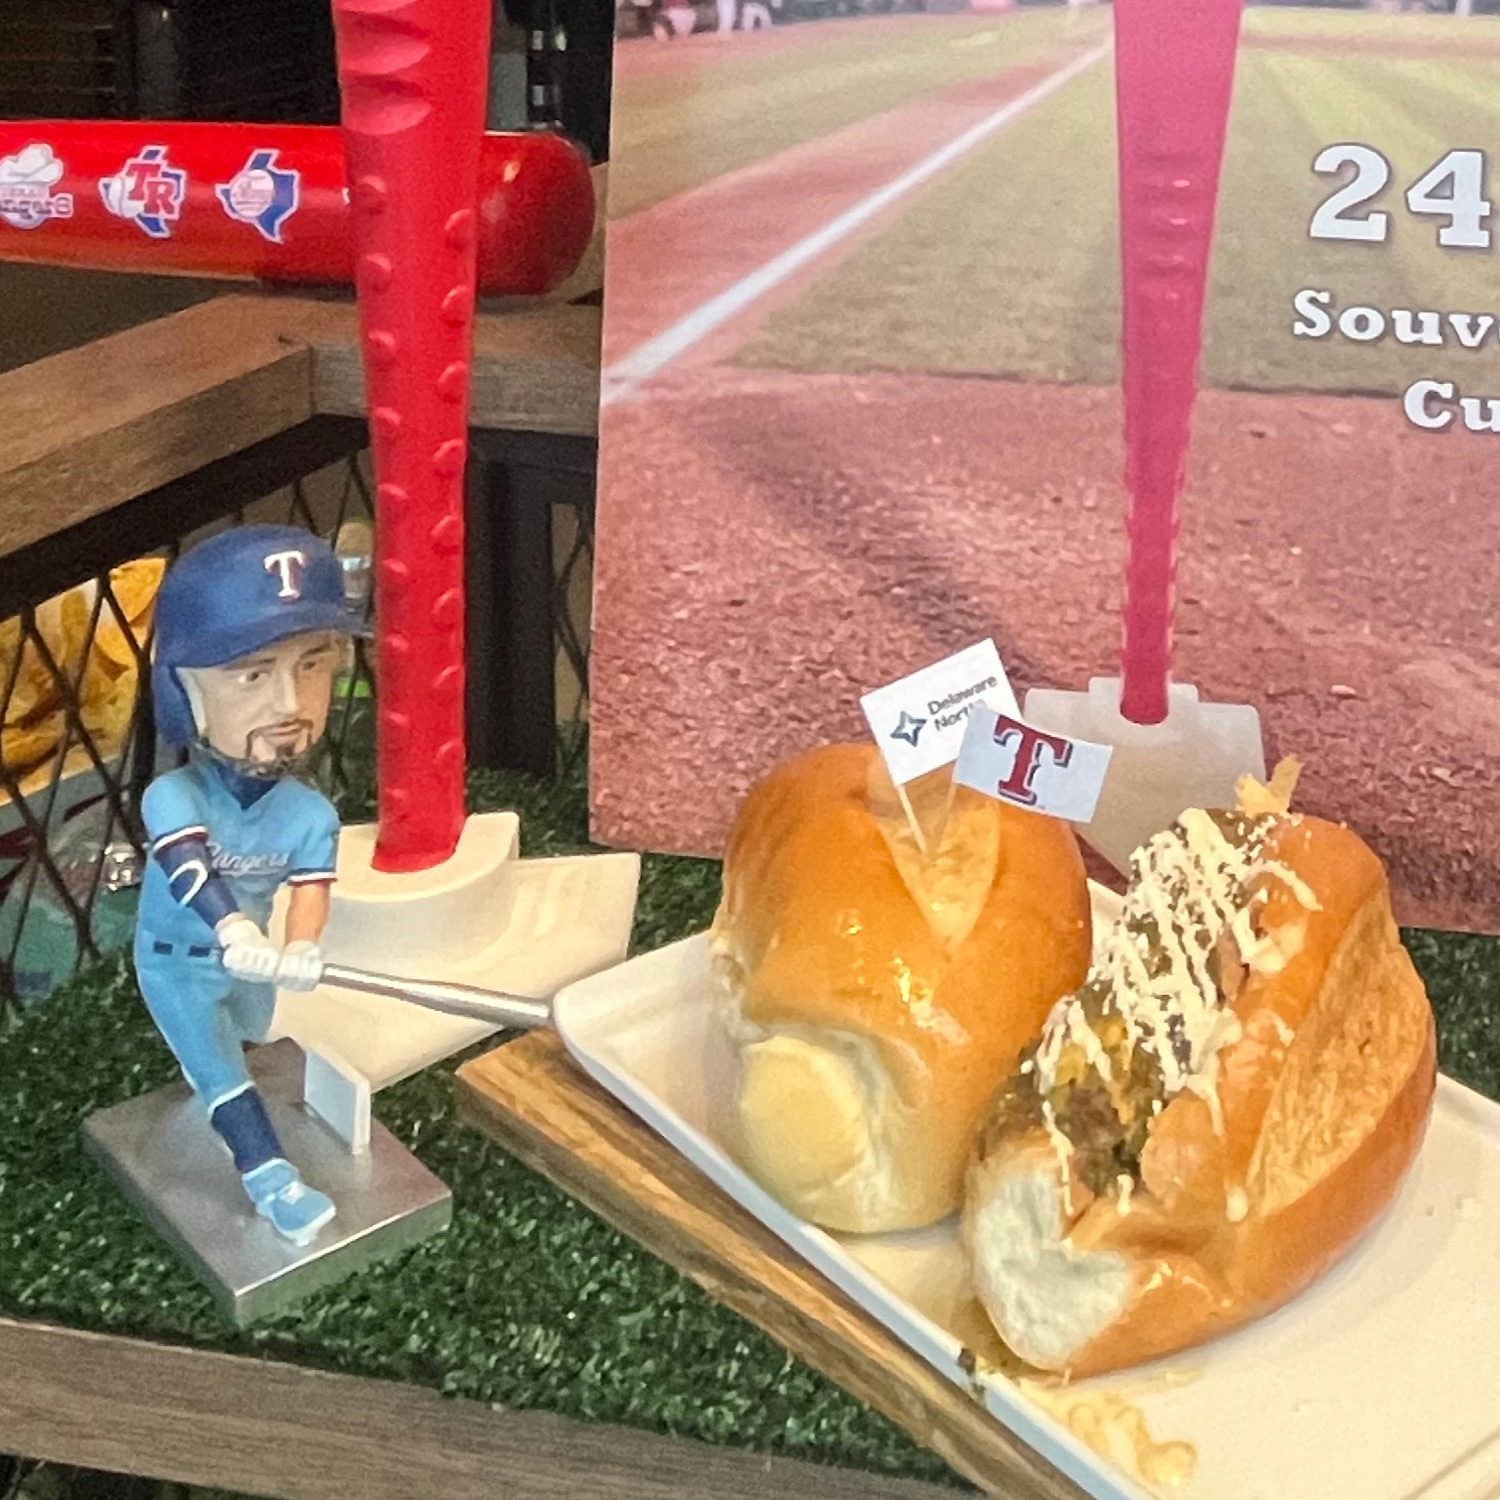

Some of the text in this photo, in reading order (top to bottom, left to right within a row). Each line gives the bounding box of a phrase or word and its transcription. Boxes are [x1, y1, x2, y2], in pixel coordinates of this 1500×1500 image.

[263, 549, 309, 604] T
[927, 675, 998, 716] Delaware
[991, 712, 1074, 807] T
